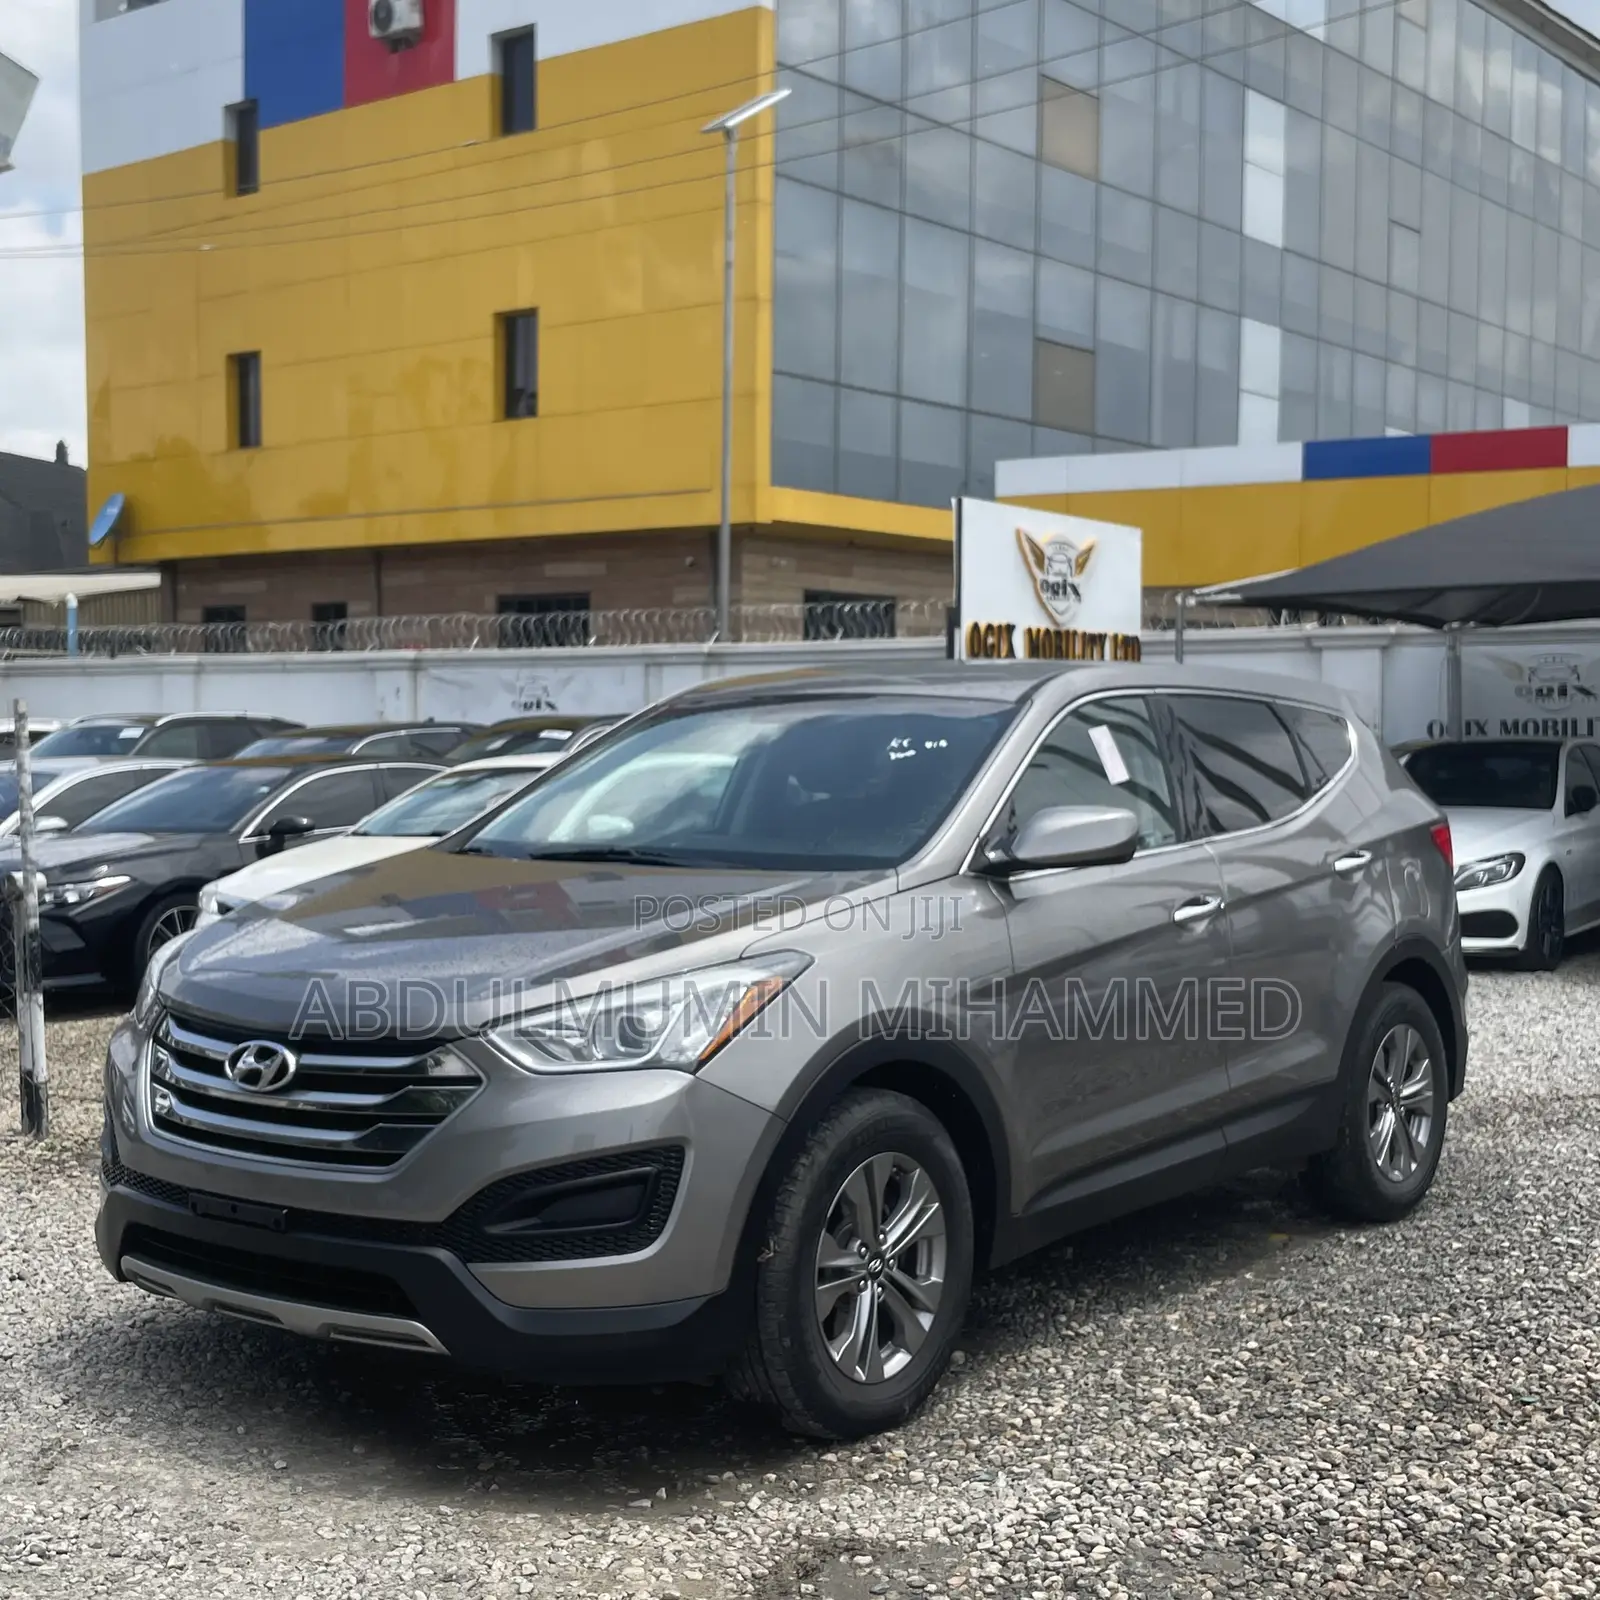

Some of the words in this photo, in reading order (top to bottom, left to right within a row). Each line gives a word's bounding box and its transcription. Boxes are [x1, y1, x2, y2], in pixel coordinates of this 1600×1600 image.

[966, 622, 1016, 659] OGIX
[1024, 627, 1107, 661] MOBILITY
[1110, 631, 1141, 662] LTD
[1426, 718, 1488, 740] OIX
